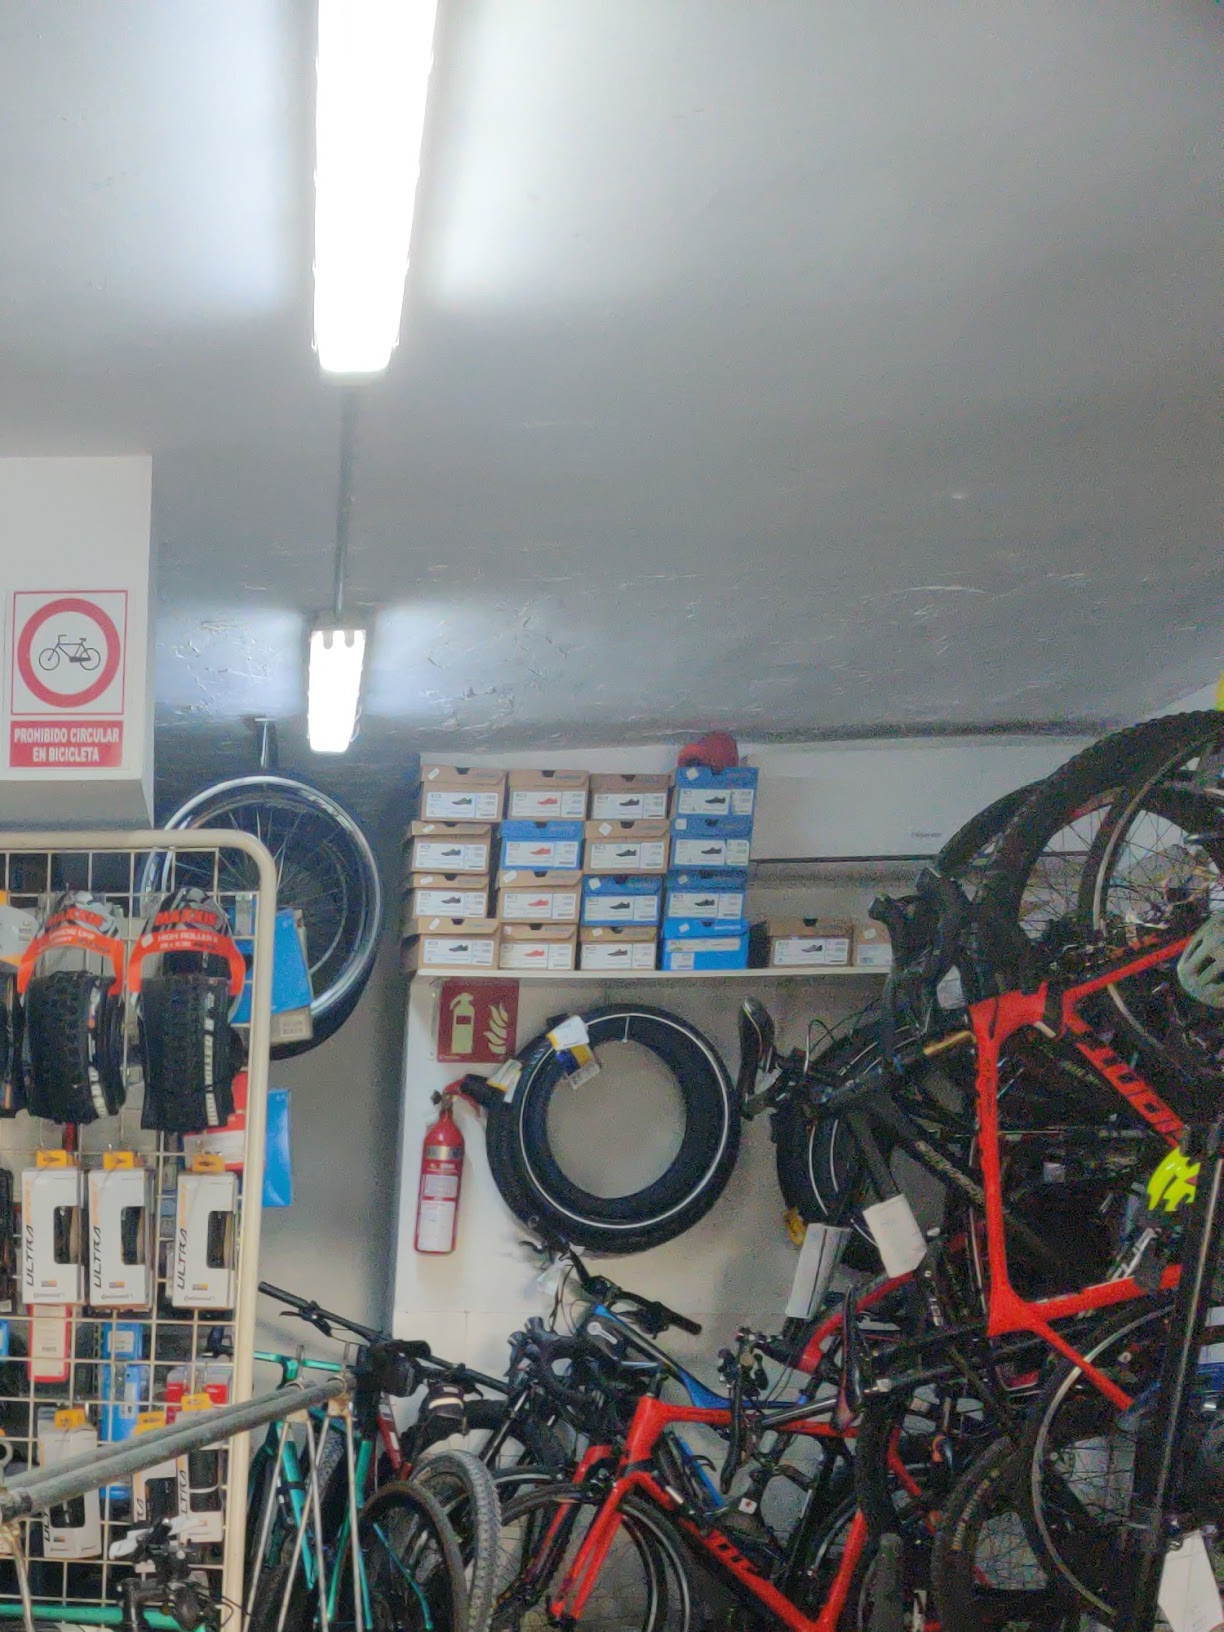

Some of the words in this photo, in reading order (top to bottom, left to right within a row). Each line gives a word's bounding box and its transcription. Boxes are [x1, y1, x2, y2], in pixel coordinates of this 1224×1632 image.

[14, 727, 67, 743] PROHIBIDO
[70, 727, 119, 742] CIRCULAR
[33, 747, 46, 762] EN
[49, 747, 99, 762] BICICLETA
[26, 1224, 34, 1287] ULTRA
[92, 1225, 102, 1289] ULTRA
[178, 1228, 188, 1290] ULTRA
